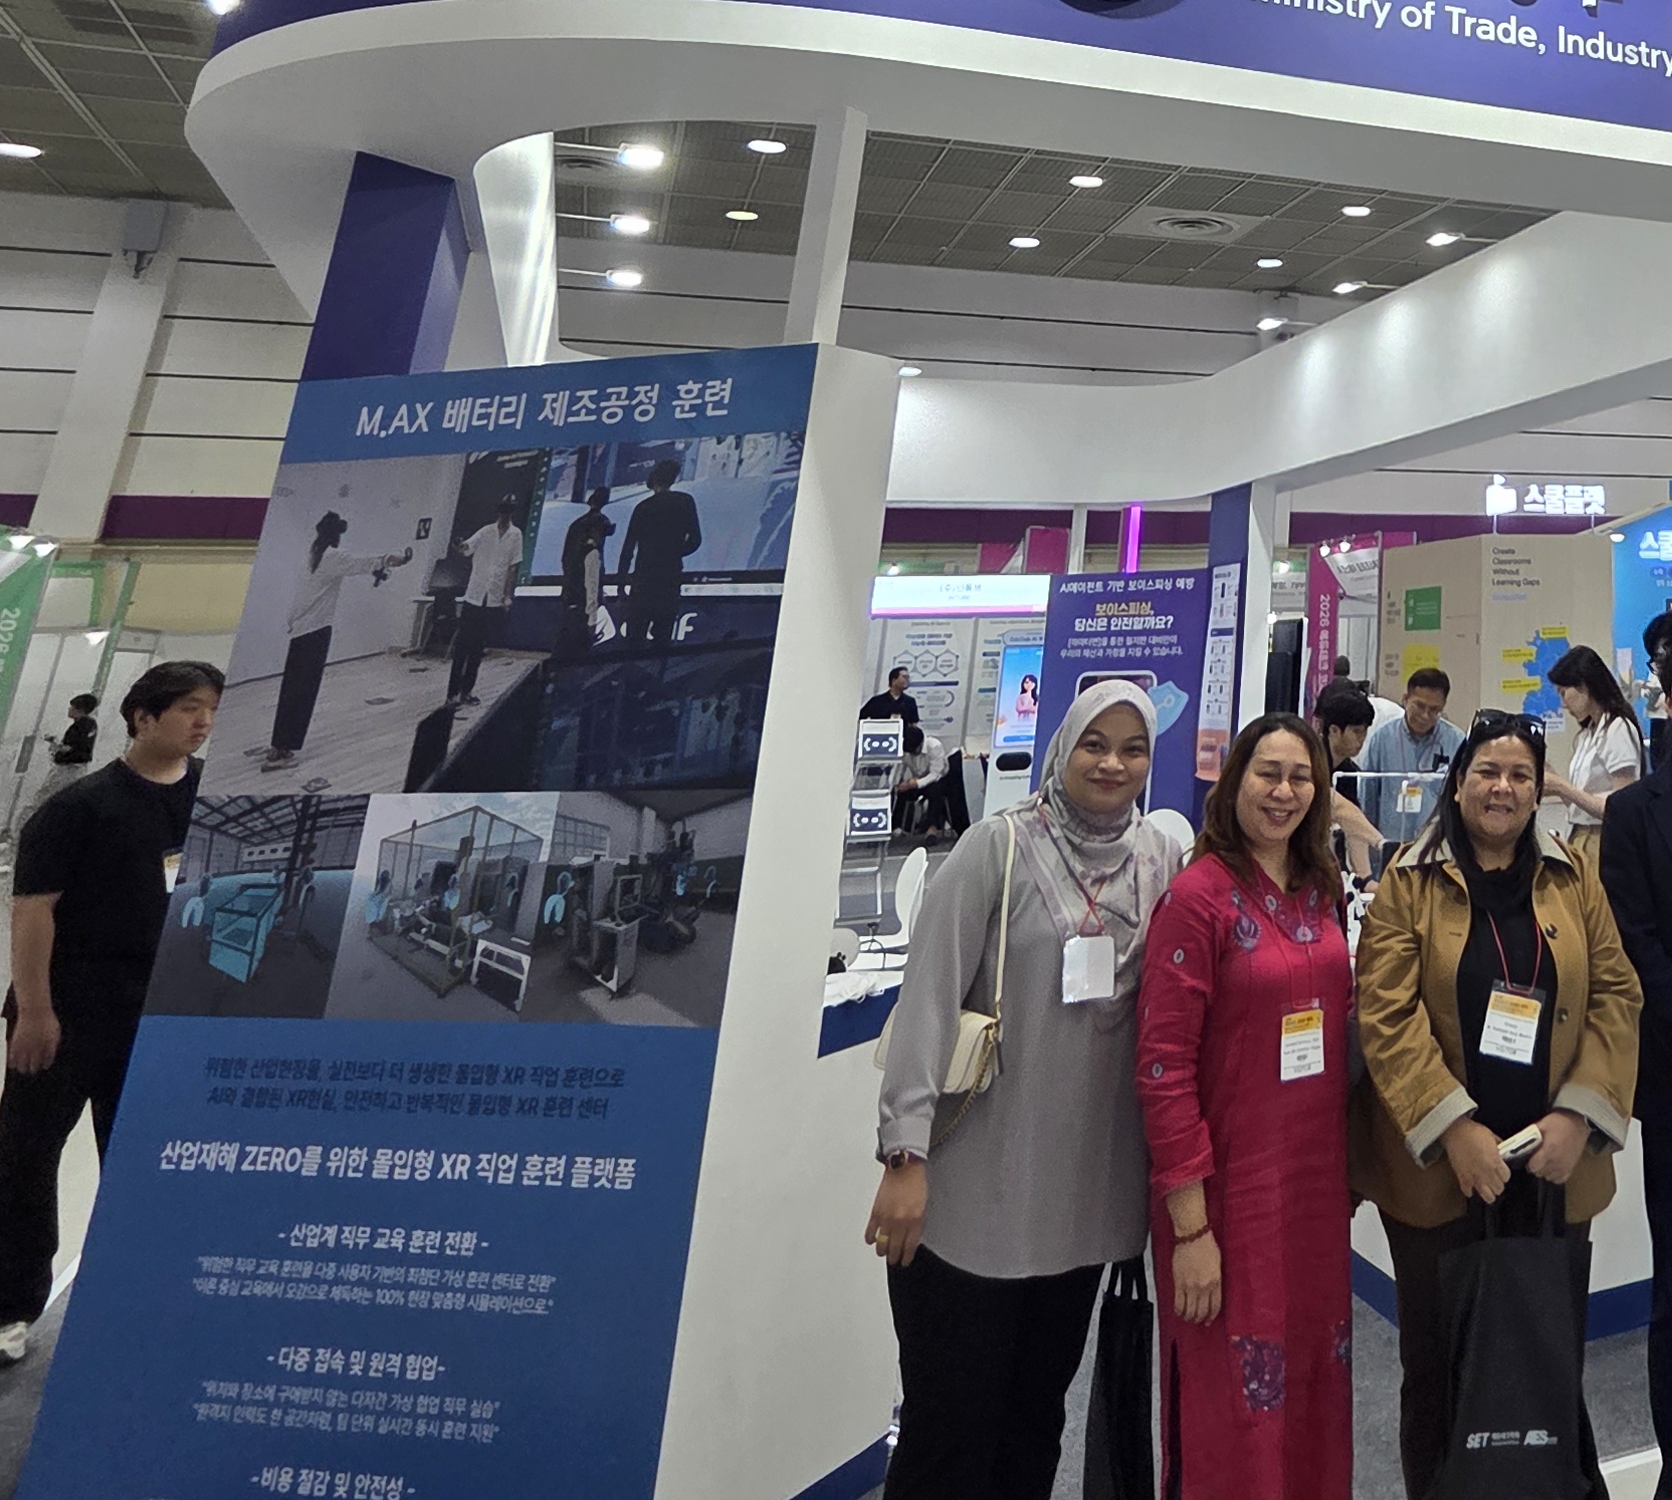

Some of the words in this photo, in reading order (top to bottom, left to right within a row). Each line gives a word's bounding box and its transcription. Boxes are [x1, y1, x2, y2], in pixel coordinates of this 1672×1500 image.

[1400, 1, 1436, 31] of
[1444, 5, 1546, 55] Trade,
[356, 401, 431, 438] M.AX
[442, 393, 527, 432] 배터리
[538, 383, 660, 426] 제조공정
[672, 377, 733, 419] 훈련
[1492, 557, 1531, 565] Classrooms
[1106, 580, 1125, 592] 기반
[1127, 578, 1173, 591] 보이스피싱
[1176, 577, 1195, 590] 예방
[1492, 578, 1521, 587] Learning
[1523, 578, 1540, 587] Gaps
[1095, 601, 1154, 616] 보이스피싱,
[1320, 594, 1330, 627] 2026
[1074, 617, 1108, 632] 당신은
[1110, 615, 1174, 630] 안전할까요?
[501, 1066, 526, 1085] XR
[529, 1065, 560, 1088] 직업
[562, 1067, 625, 1089] 훈련으로
[514, 1097, 539, 1116] XR
[543, 1096, 573, 1118] 훈련
[577, 1097, 609, 1120] 센터
[160, 1140, 241, 1174] 산업재해
[241, 1145, 323, 1177] ZERO를
[327, 1146, 368, 1178] 위한
[372, 1148, 435, 1181] 몰입형
[437, 1153, 472, 1181] XR
[475, 1152, 519, 1185] 직업
[521, 1154, 567, 1187] 훈련
[570, 1156, 636, 1190] 플랫폼
[341, 1225, 371, 1250] 직무
[373, 1228, 405, 1252] 교육
[408, 1230, 441, 1254] 훈련
[444, 1231, 478, 1256] 전환
[256, 1259, 280, 1277] 교육
[314, 1261, 337, 1280] 다중
[338, 1263, 372, 1282] 사용자
[441, 1268, 465, 1288] 가상
[466, 1271, 491, 1289] 훈련
[492, 1272, 526, 1290] 센터로
[241, 1279, 285, 1299] 교육에서
[285, 1282, 328, 1301] 오감으로
[375, 1288, 405, 1306] 100%
[407, 1289, 431, 1309] 현장
[314, 1347, 346, 1375] 접속
[349, 1350, 366, 1376] 및
[368, 1351, 403, 1379] 원격
[388, 1393, 414, 1414] 가상
[416, 1395, 441, 1415] 협업
[443, 1397, 467, 1416] 직무
[351, 1413, 376, 1432] 단위
[377, 1416, 413, 1436] 실시간
[415, 1418, 440, 1438] 동시
[441, 1420, 467, 1441] 훈련
[1466, 1432, 1490, 1448] SET
[297, 1468, 331, 1497] 절감
[333, 1471, 351, 1498] 및
[353, 1472, 404, 1500] 안전성
